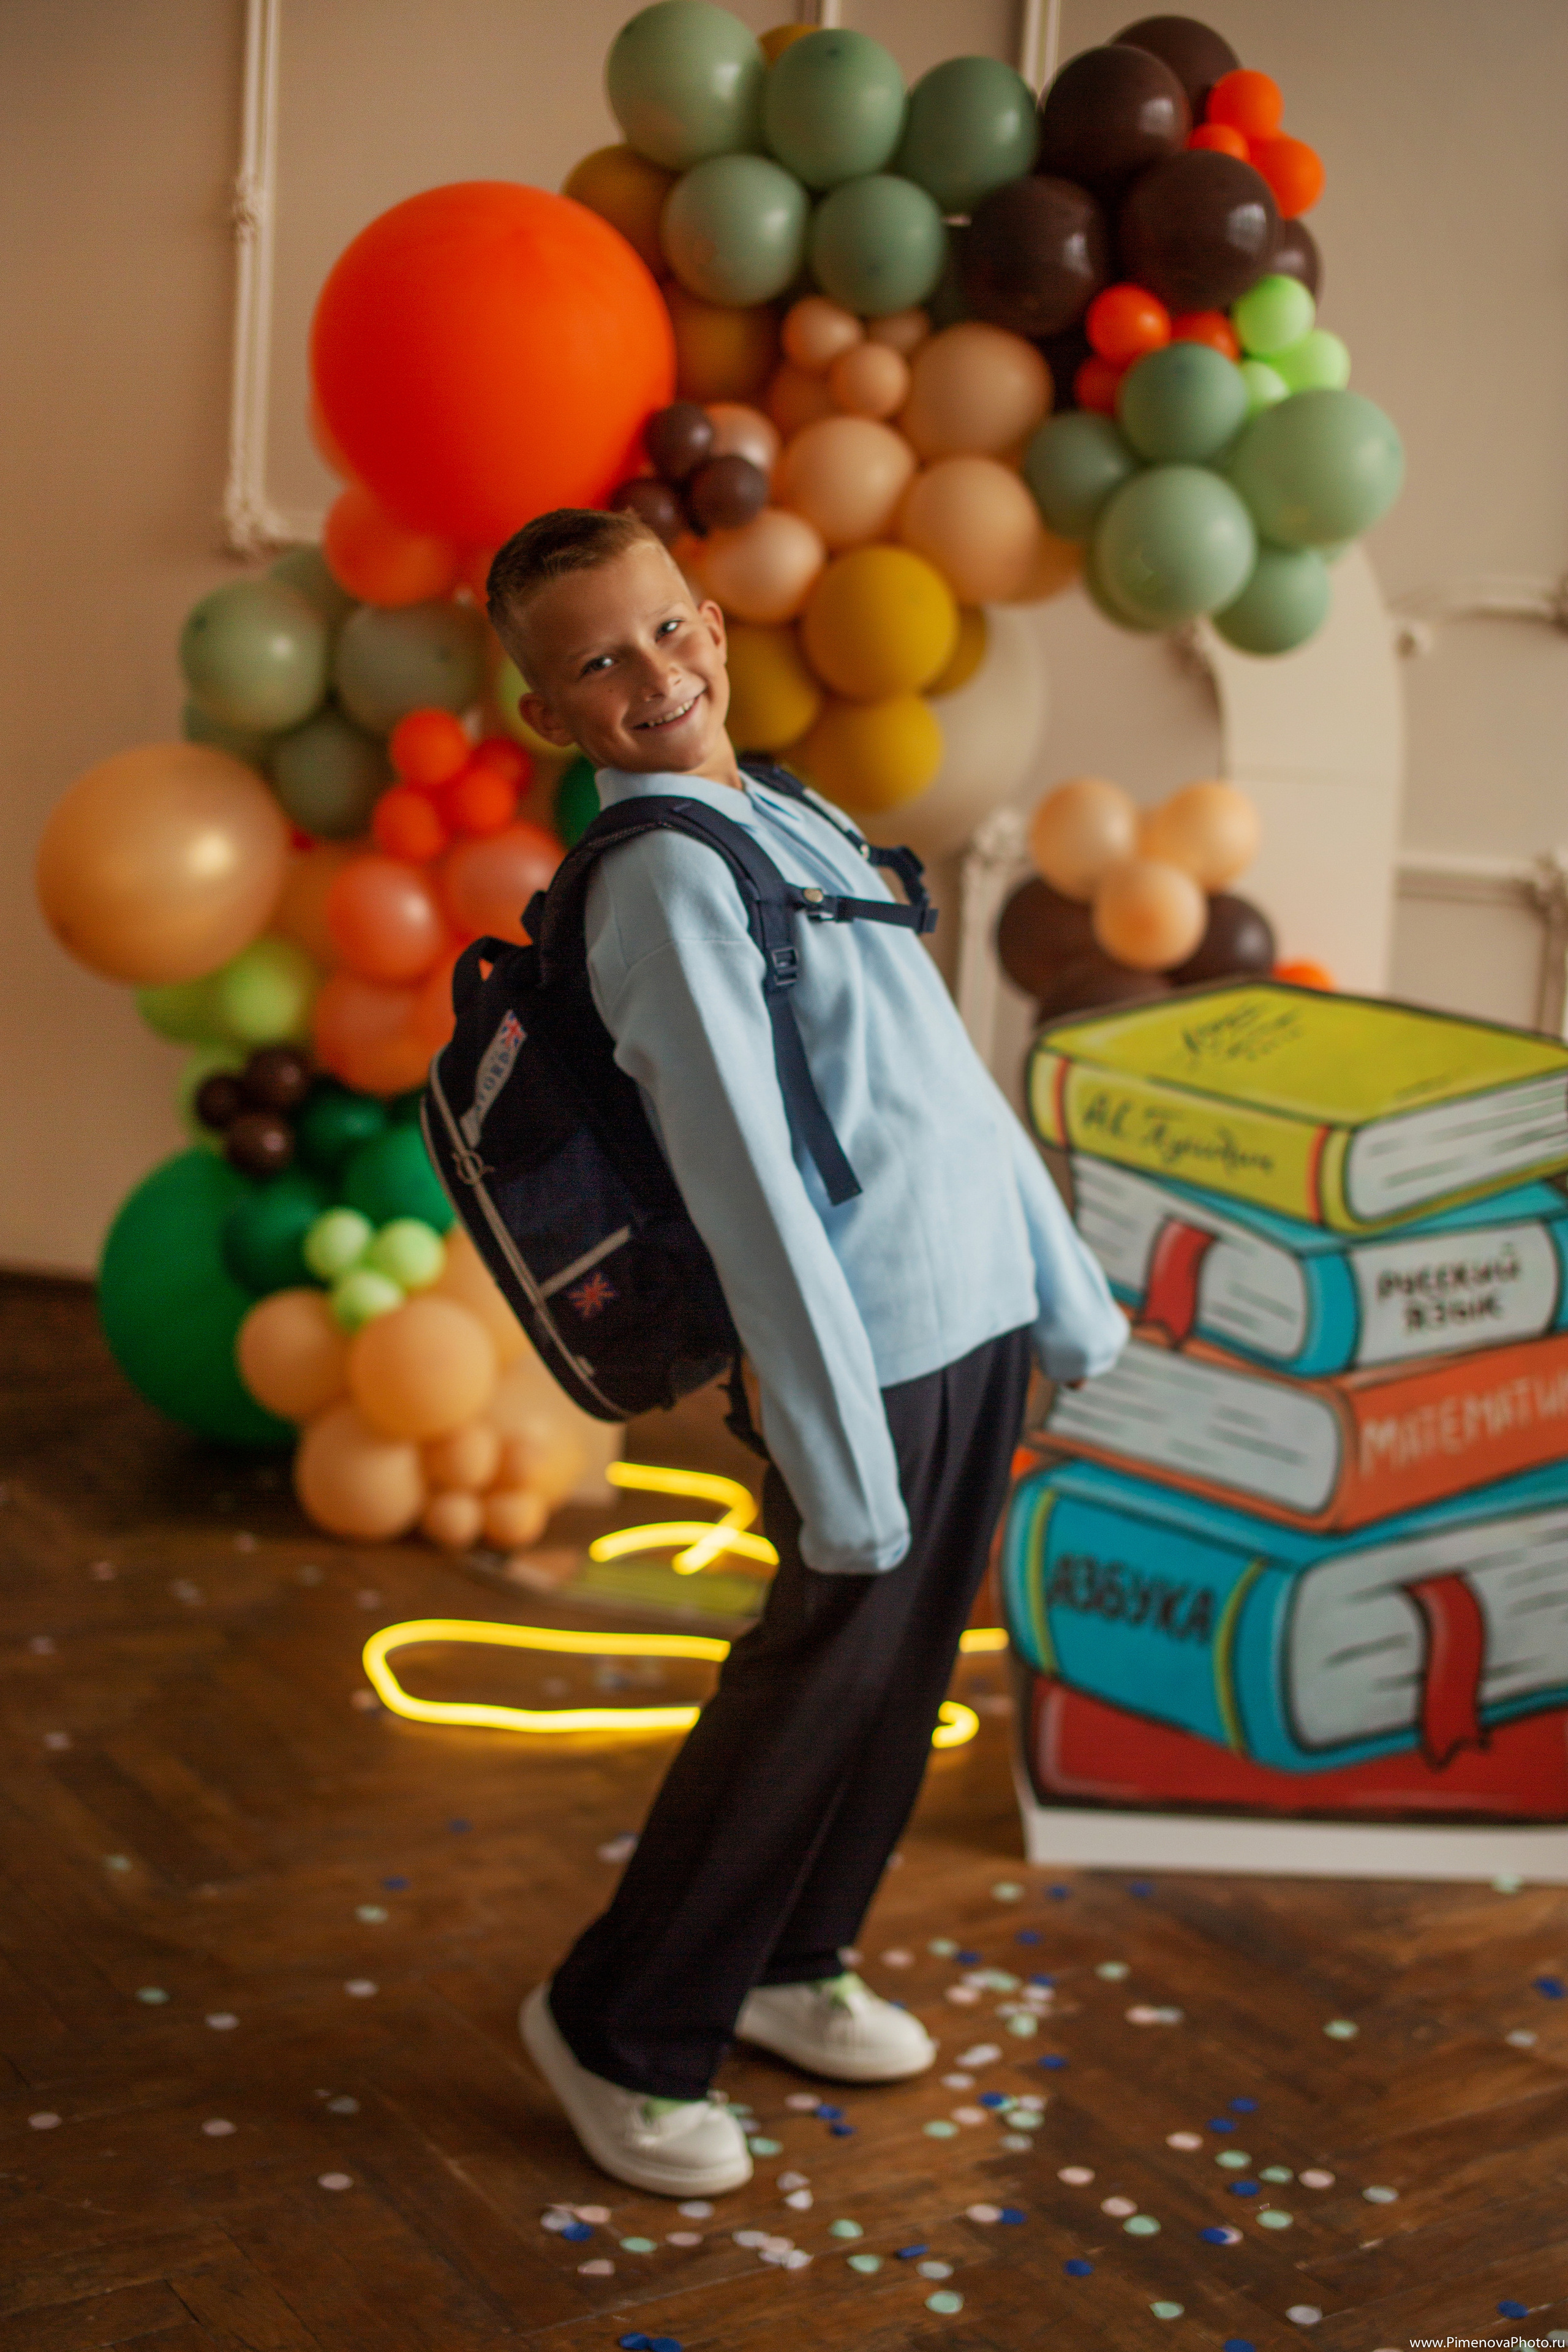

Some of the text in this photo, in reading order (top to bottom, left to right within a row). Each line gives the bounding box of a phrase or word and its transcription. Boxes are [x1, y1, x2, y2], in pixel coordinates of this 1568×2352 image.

[1376, 1241, 1521, 1301] РУССКИЙ
[1405, 1294, 1502, 1334] ЯЗЫК
[1046, 1553, 1215, 1645] АЗБУКА
